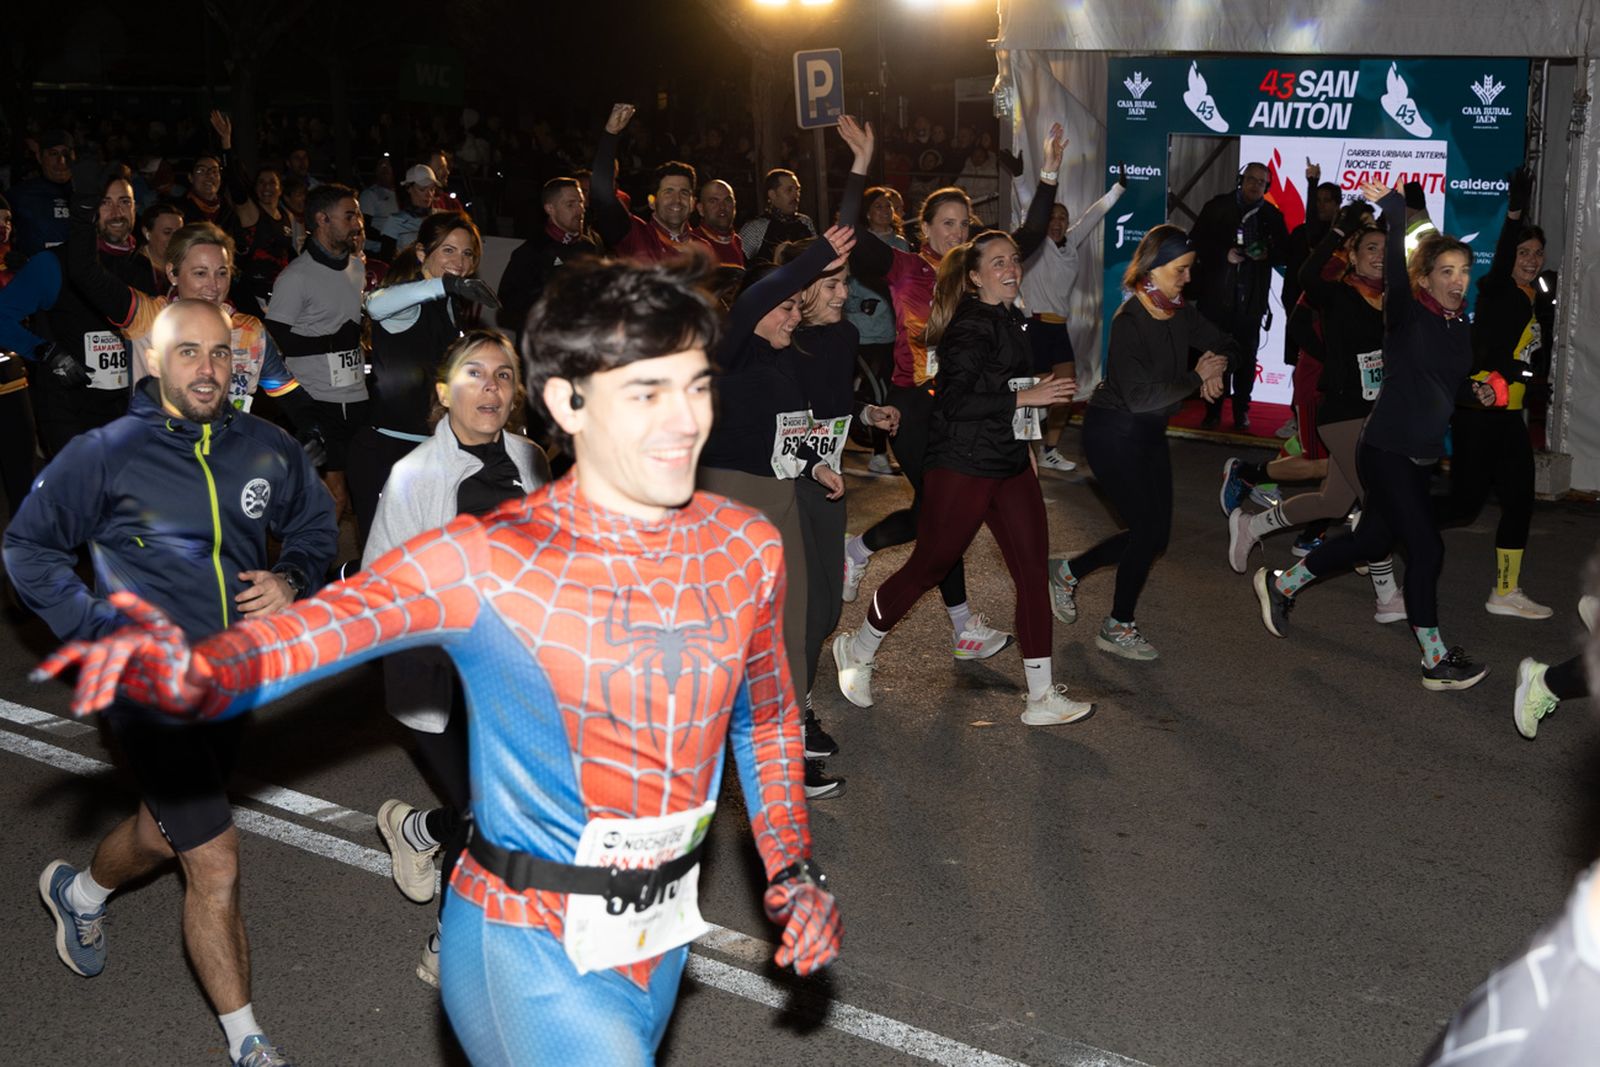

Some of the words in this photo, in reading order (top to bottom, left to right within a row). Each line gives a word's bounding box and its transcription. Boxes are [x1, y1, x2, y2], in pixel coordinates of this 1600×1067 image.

[416, 64, 452, 88] WC
[1259, 69, 1296, 99] 43
[1296, 70, 1359, 98] SAN
[806, 59, 834, 118] P
[1196, 101, 1215, 121] 43
[1248, 94, 1353, 130] ANTÓN
[1395, 104, 1416, 125] 43
[1483, 107, 1512, 116] RURAL
[1346, 149, 1380, 158] CARRERA
[1382, 150, 1412, 158] URBANA
[1345, 160, 1377, 169] NOCHE
[1379, 161, 1392, 169] DE
[99, 350, 127, 370] 648
